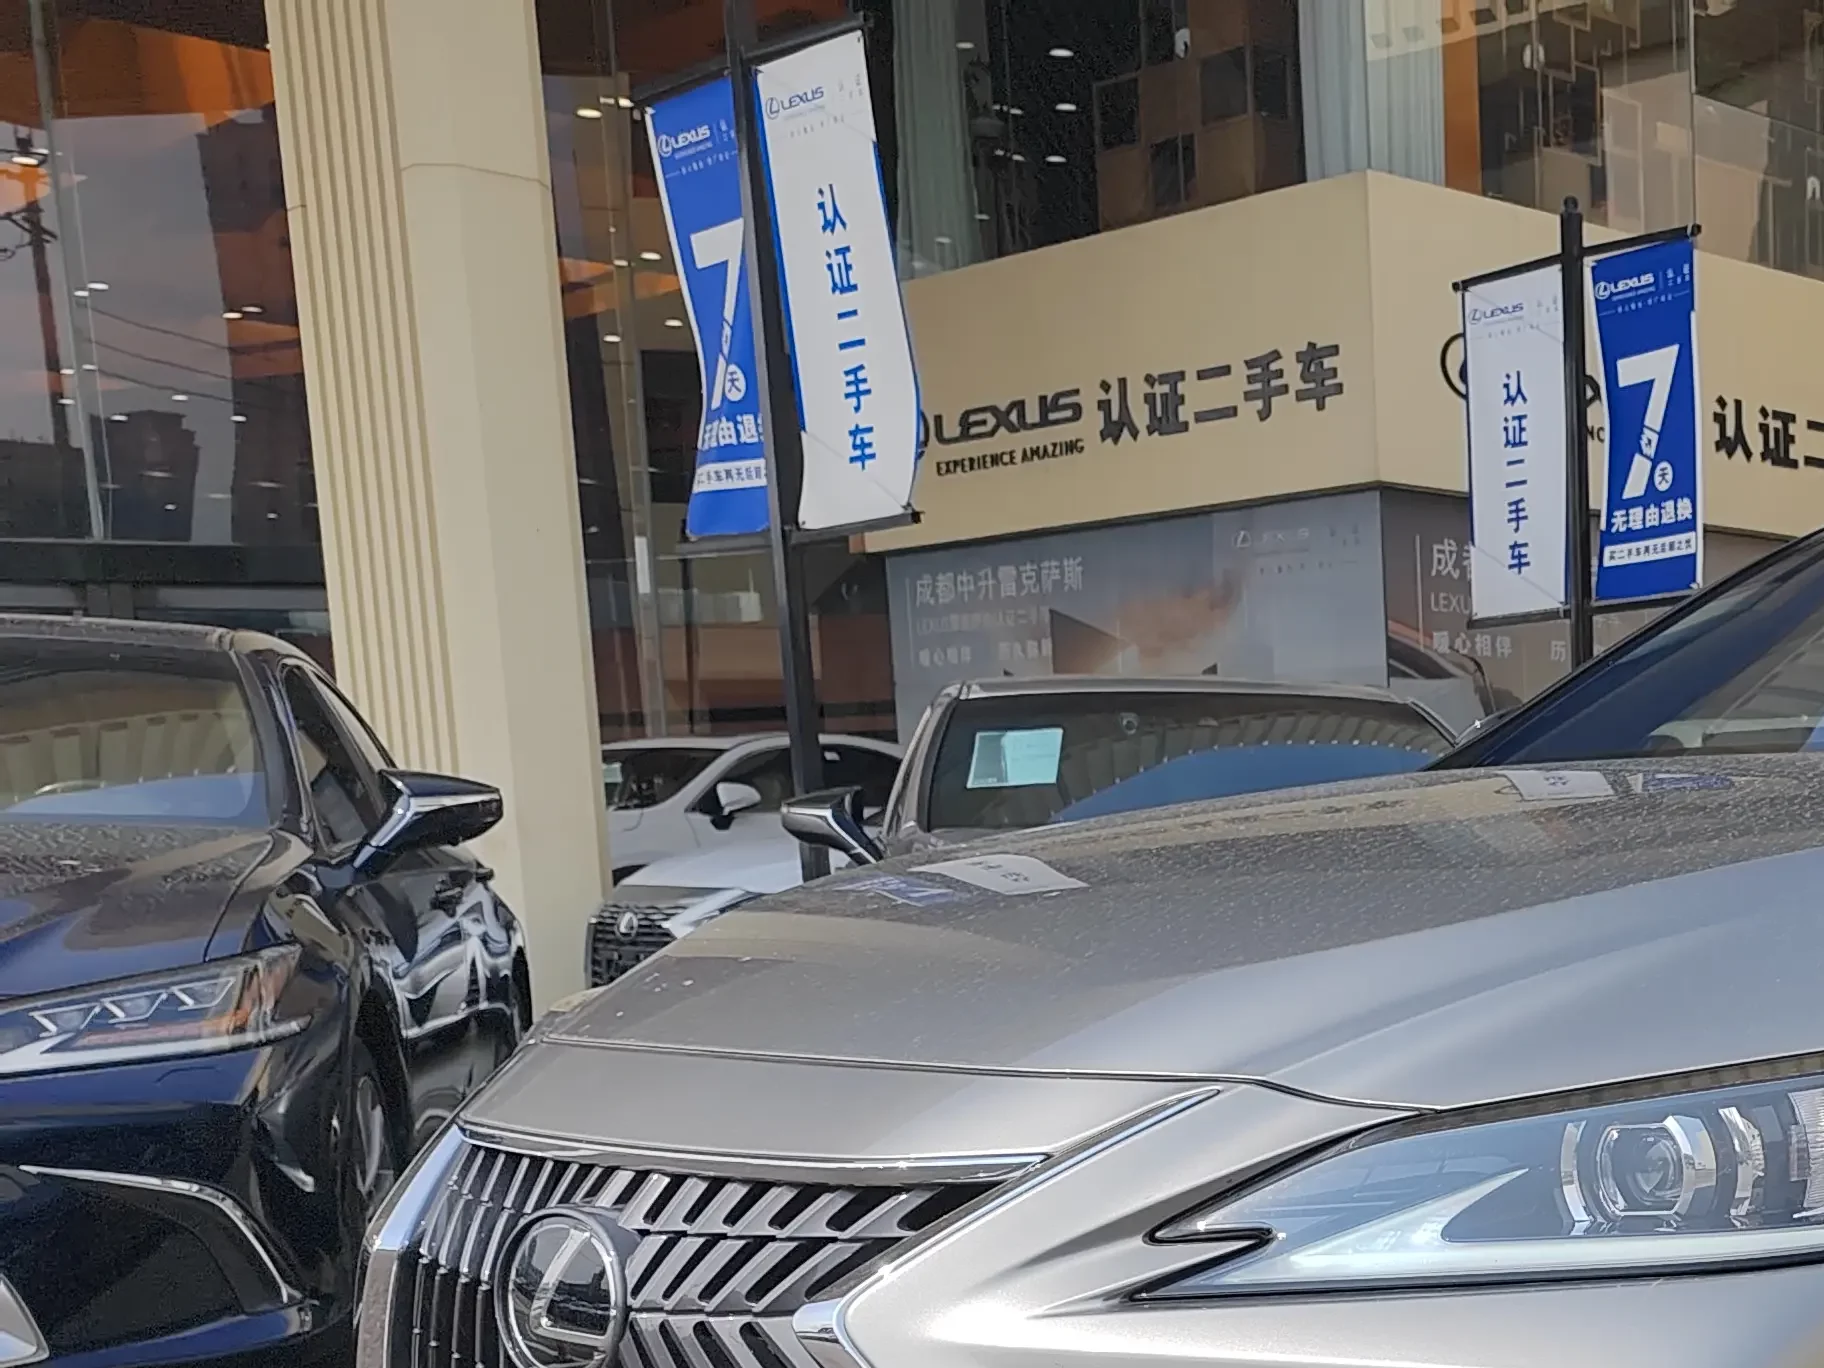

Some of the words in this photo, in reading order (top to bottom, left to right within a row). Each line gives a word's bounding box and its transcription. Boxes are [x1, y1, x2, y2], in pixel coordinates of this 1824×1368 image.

[780, 86, 824, 110] LEXUS
[671, 125, 710, 148] LEXUS
[1610, 272, 1655, 293] LEXUS
[691, 217, 744, 411] 7
[817, 184, 877, 471] 认证二手车
[1483, 302, 1524, 319] LEXUS
[727, 371, 742, 394] 天
[1097, 341, 1343, 446] 认证二手车
[934, 388, 1083, 446] LEXUS
[1616, 343, 1680, 500] 7
[936, 449, 1018, 477] EXPERIENCE
[1021, 438, 1085, 463] AMAZING
[1502, 371, 1531, 575] 认证二手车
[1658, 466, 1670, 486] 天
[1611, 497, 1693, 533] 无理由退换
[915, 556, 1083, 608] 成都中升雷克萨斯
